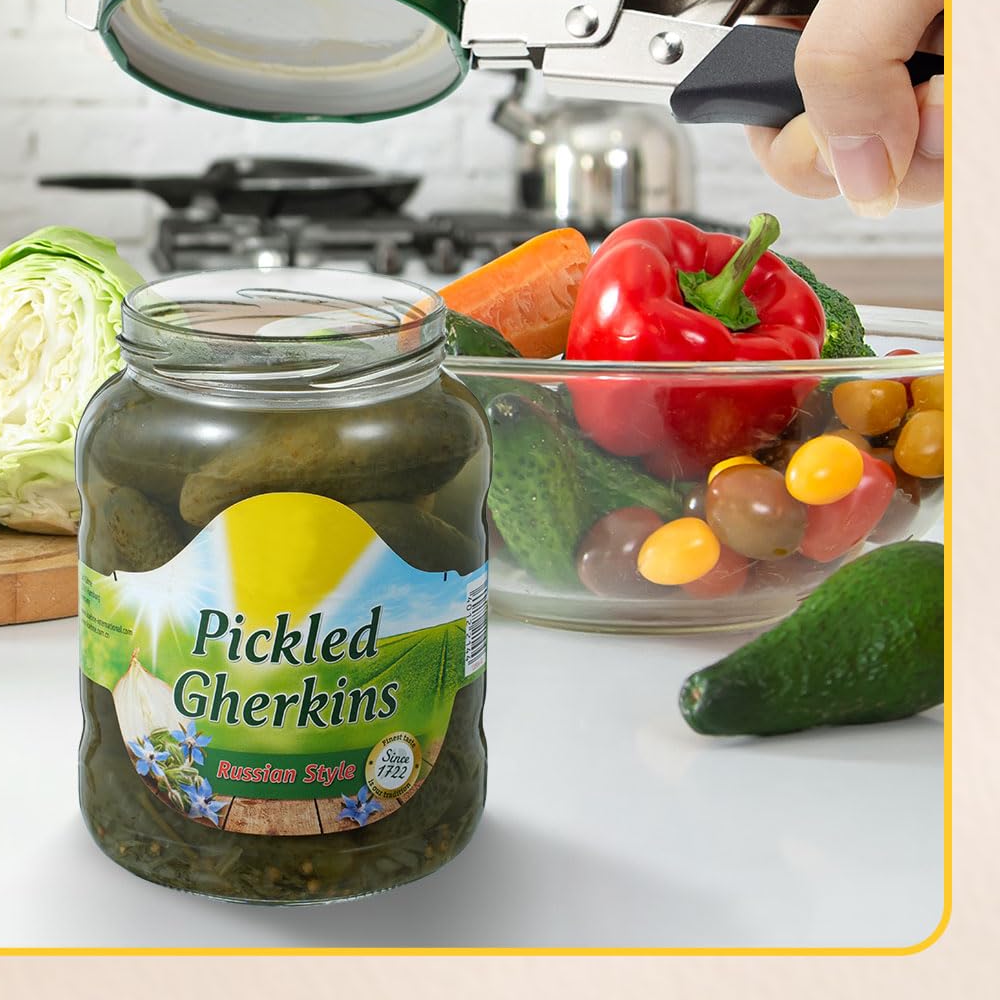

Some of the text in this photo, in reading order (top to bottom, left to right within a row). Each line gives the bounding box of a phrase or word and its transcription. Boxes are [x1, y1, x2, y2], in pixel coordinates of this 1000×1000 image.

[191, 605, 382, 665] Pickled
[172, 669, 399, 728] Gherkins
[381, 748, 410, 764] Since
[215, 760, 357, 787] Russian Style
[377, 764, 408, 779] 1722
